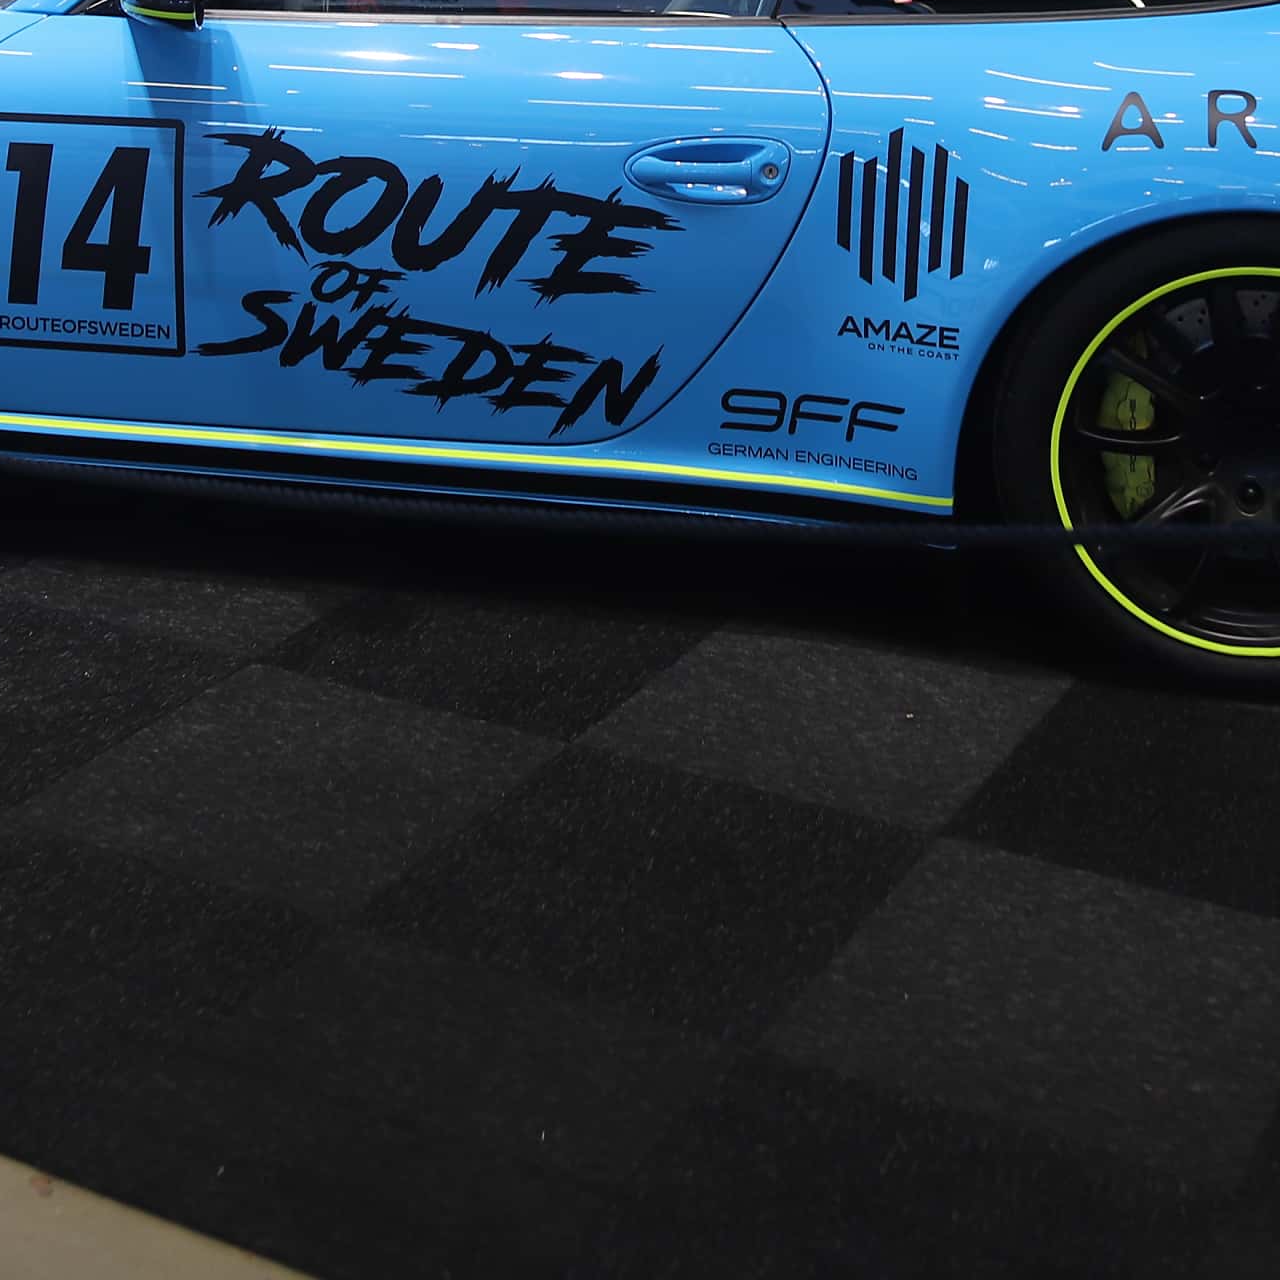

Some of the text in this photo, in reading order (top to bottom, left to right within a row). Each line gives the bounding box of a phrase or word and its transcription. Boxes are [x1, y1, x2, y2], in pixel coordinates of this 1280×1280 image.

[6, 140, 153, 311] 14
[192, 124, 687, 306] ROUTE
[309, 260, 408, 311] OF
[837, 315, 960, 350] AMAZE
[867, 341, 960, 361] ON THE COAST
[188, 289, 665, 439] SWEDEN
[720, 387, 906, 443] 9FF
[707, 441, 918, 482] GERMAN ENGINEERING
